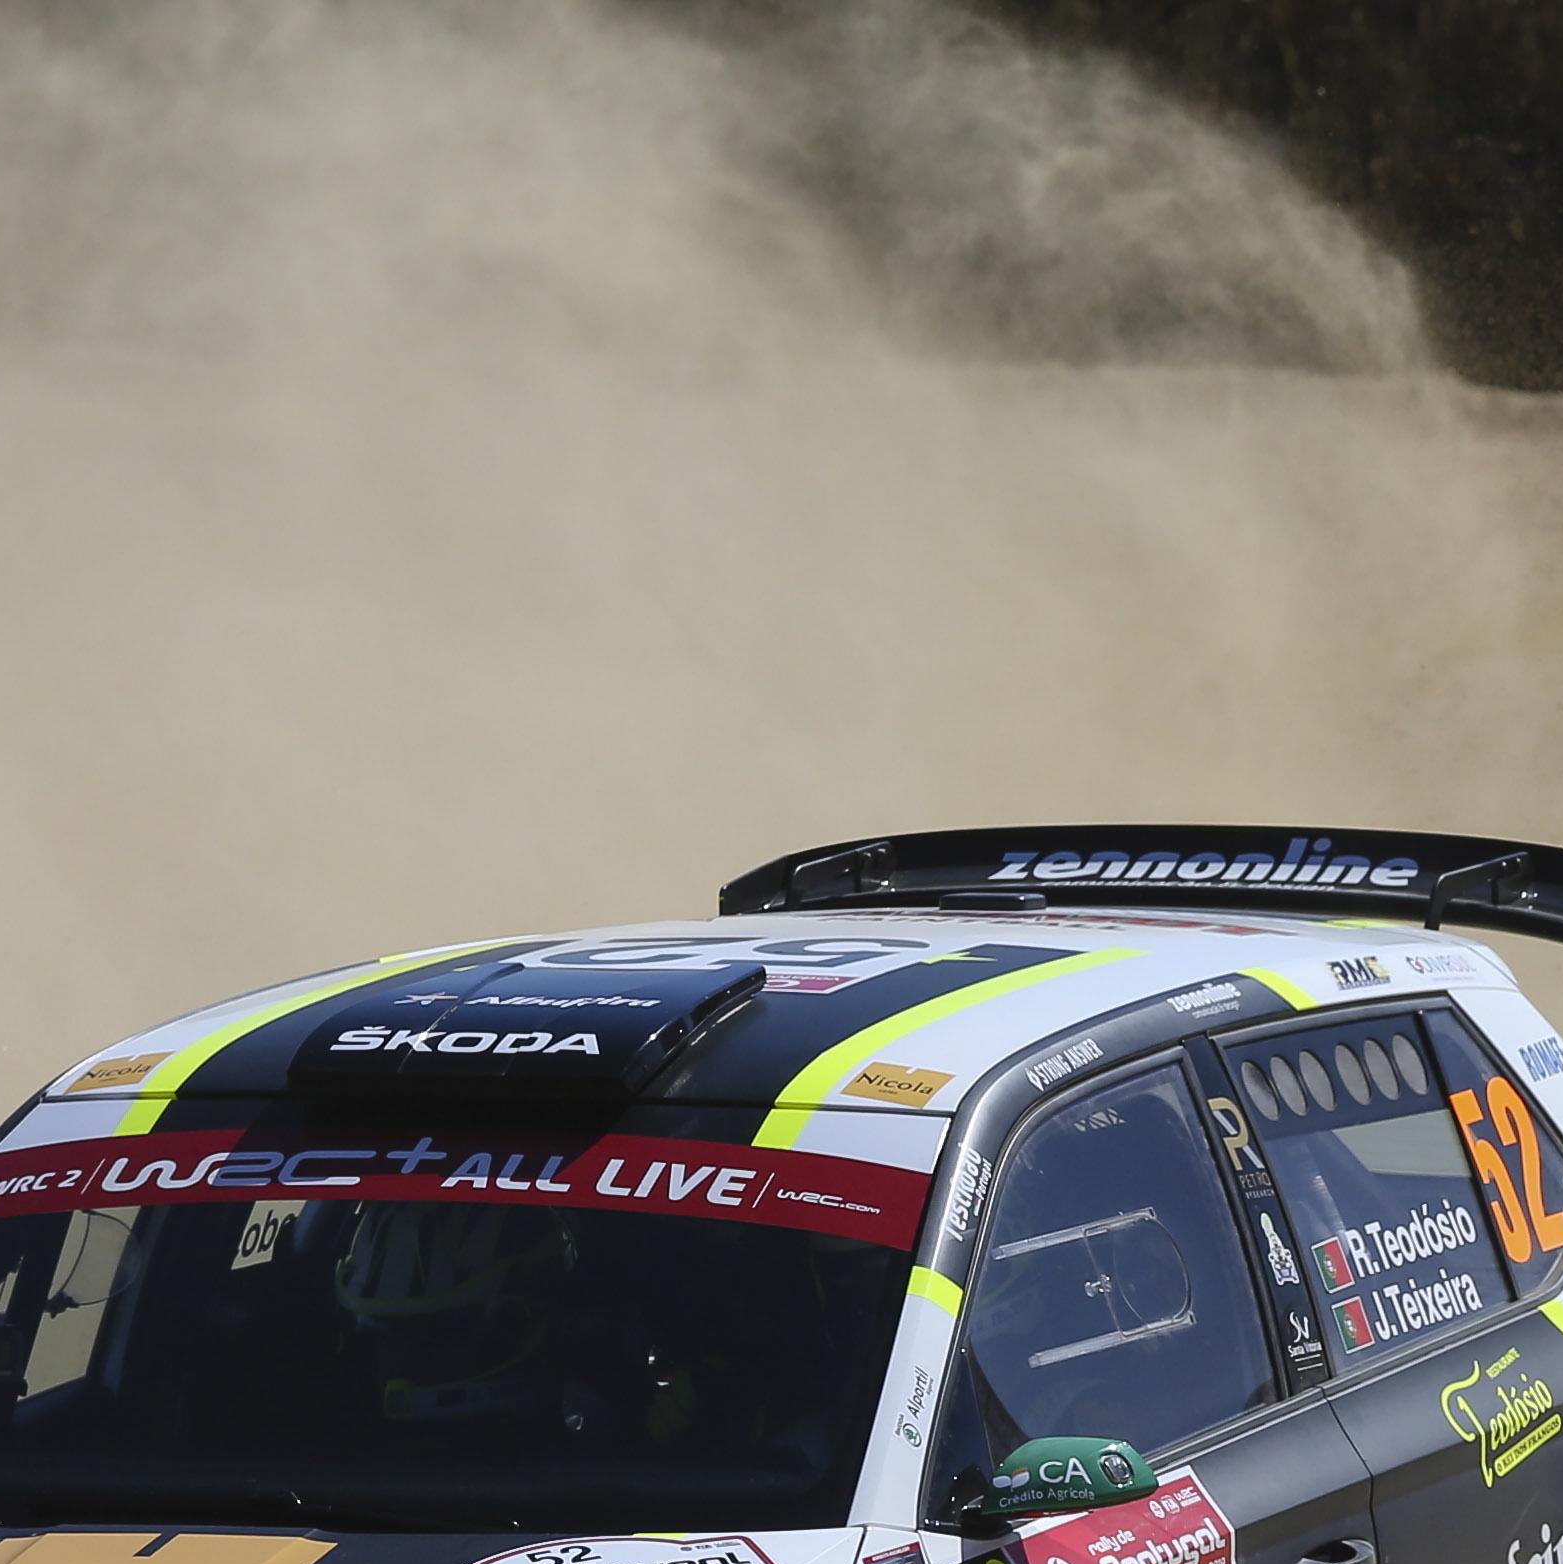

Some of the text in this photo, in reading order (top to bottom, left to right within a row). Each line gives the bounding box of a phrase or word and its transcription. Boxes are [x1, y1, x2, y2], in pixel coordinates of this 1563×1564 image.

[988, 836, 1419, 887] zennonline
[330, 1026, 601, 1054] ŠKODA
[86, 1061, 153, 1081] Nicola
[1035, 1038, 1104, 1085] STRONG ANSWER
[855, 1070, 934, 1098] Nicola
[57, 1169, 83, 1189] 2
[441, 1152, 757, 1207] ALL LIVE
[1240, 1172, 1272, 1189] PETRO
[777, 1187, 880, 1215] WRC.com
[1346, 1198, 1476, 1280] R.Teodósio
[1374, 1272, 1482, 1341] J.Teixeira
[1441, 1360, 1553, 1488] Teodósio
[1515, 1442, 1527, 1459] DOS
[1528, 1419, 1561, 1452] FRANGOS
[1039, 1457, 1092, 1486] CA
[998, 1486, 1096, 1509] Crédito Agrícola
[1088, 1529, 1136, 1556] rally de
